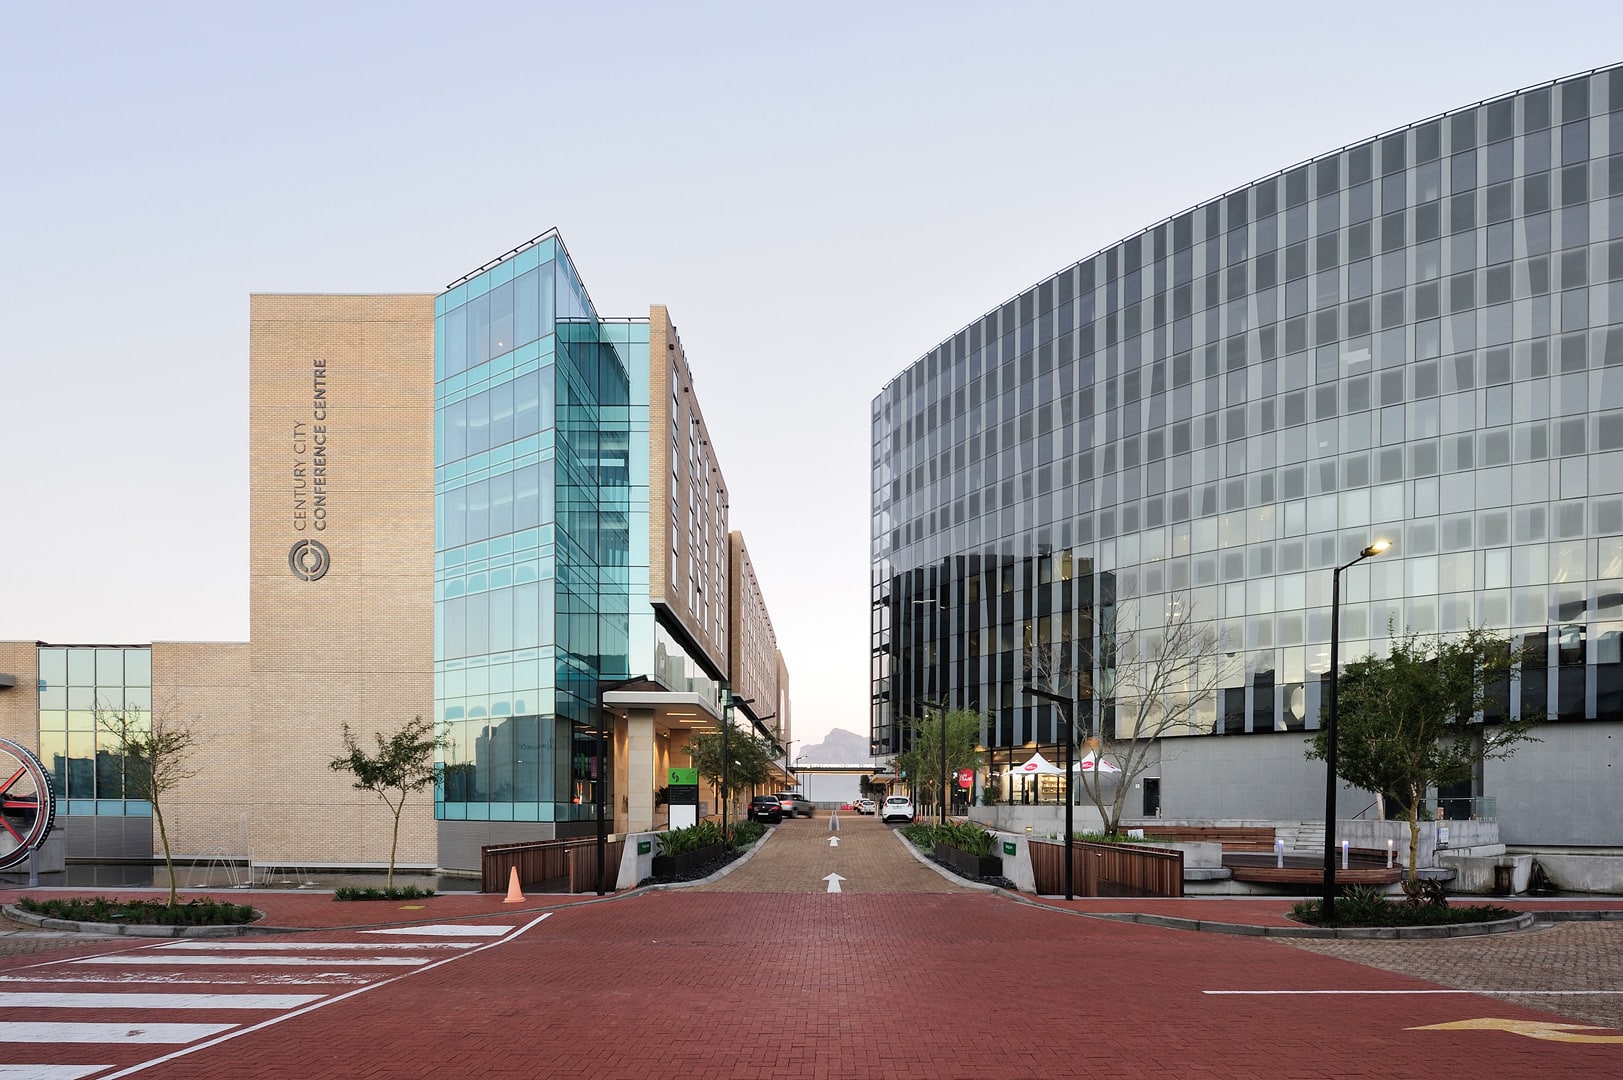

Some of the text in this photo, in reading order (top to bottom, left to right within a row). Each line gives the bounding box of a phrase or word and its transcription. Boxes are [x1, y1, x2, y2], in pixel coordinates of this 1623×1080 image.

[294, 420, 306, 531] CENTURY CITY
[313, 358, 327, 531] CONFERENCE CENTRE
